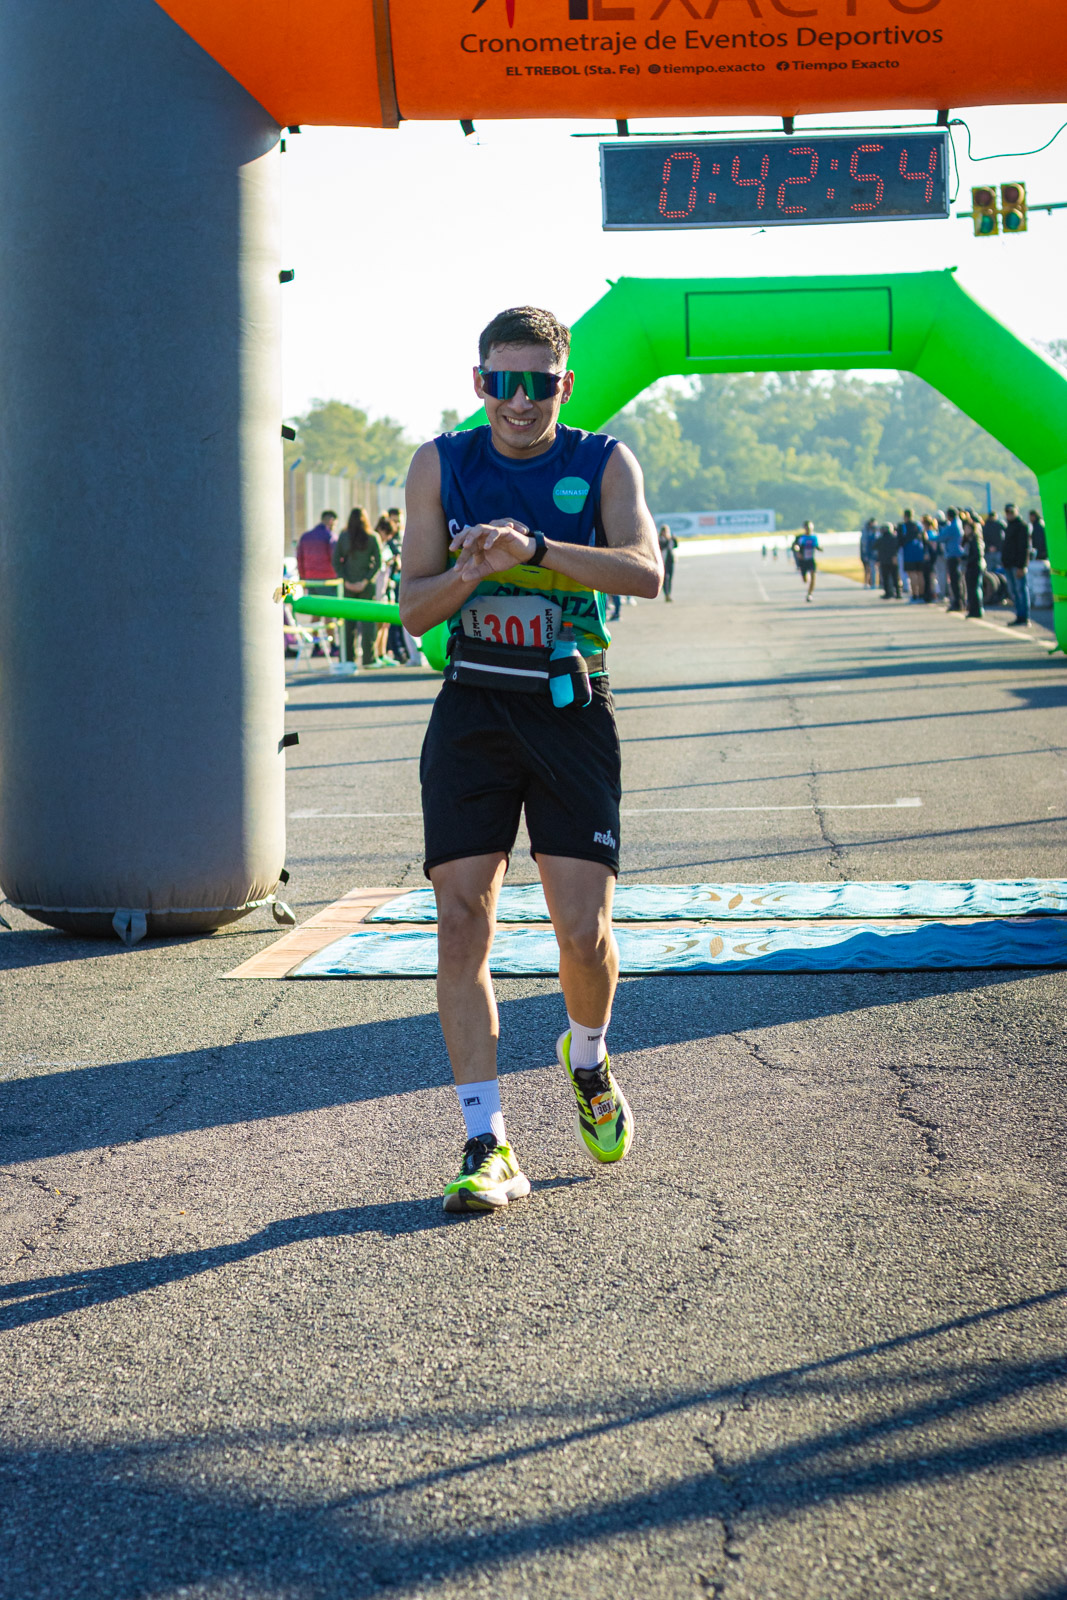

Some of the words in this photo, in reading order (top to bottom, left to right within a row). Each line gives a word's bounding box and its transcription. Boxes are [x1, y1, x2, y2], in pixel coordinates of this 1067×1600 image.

[460, 32, 637, 56] Cronometraje
[644, 30, 677, 50] de
[685, 30, 788, 50] Eventos
[797, 25, 943, 50] Deportivos
[506, 66, 523, 76] EL
[525, 65, 581, 76] TREBOL
[584, 64, 616, 76] (Sta.
[619, 64, 641, 75] Fe)
[663, 62, 766, 75] tiempo.exacto
[792, 60, 848, 71] Tiempo
[851, 58, 900, 69] Exacto
[658, 144, 938, 218] 0:42:54
[469, 609, 482, 640] TIEM
[484, 614, 546, 648] 301
